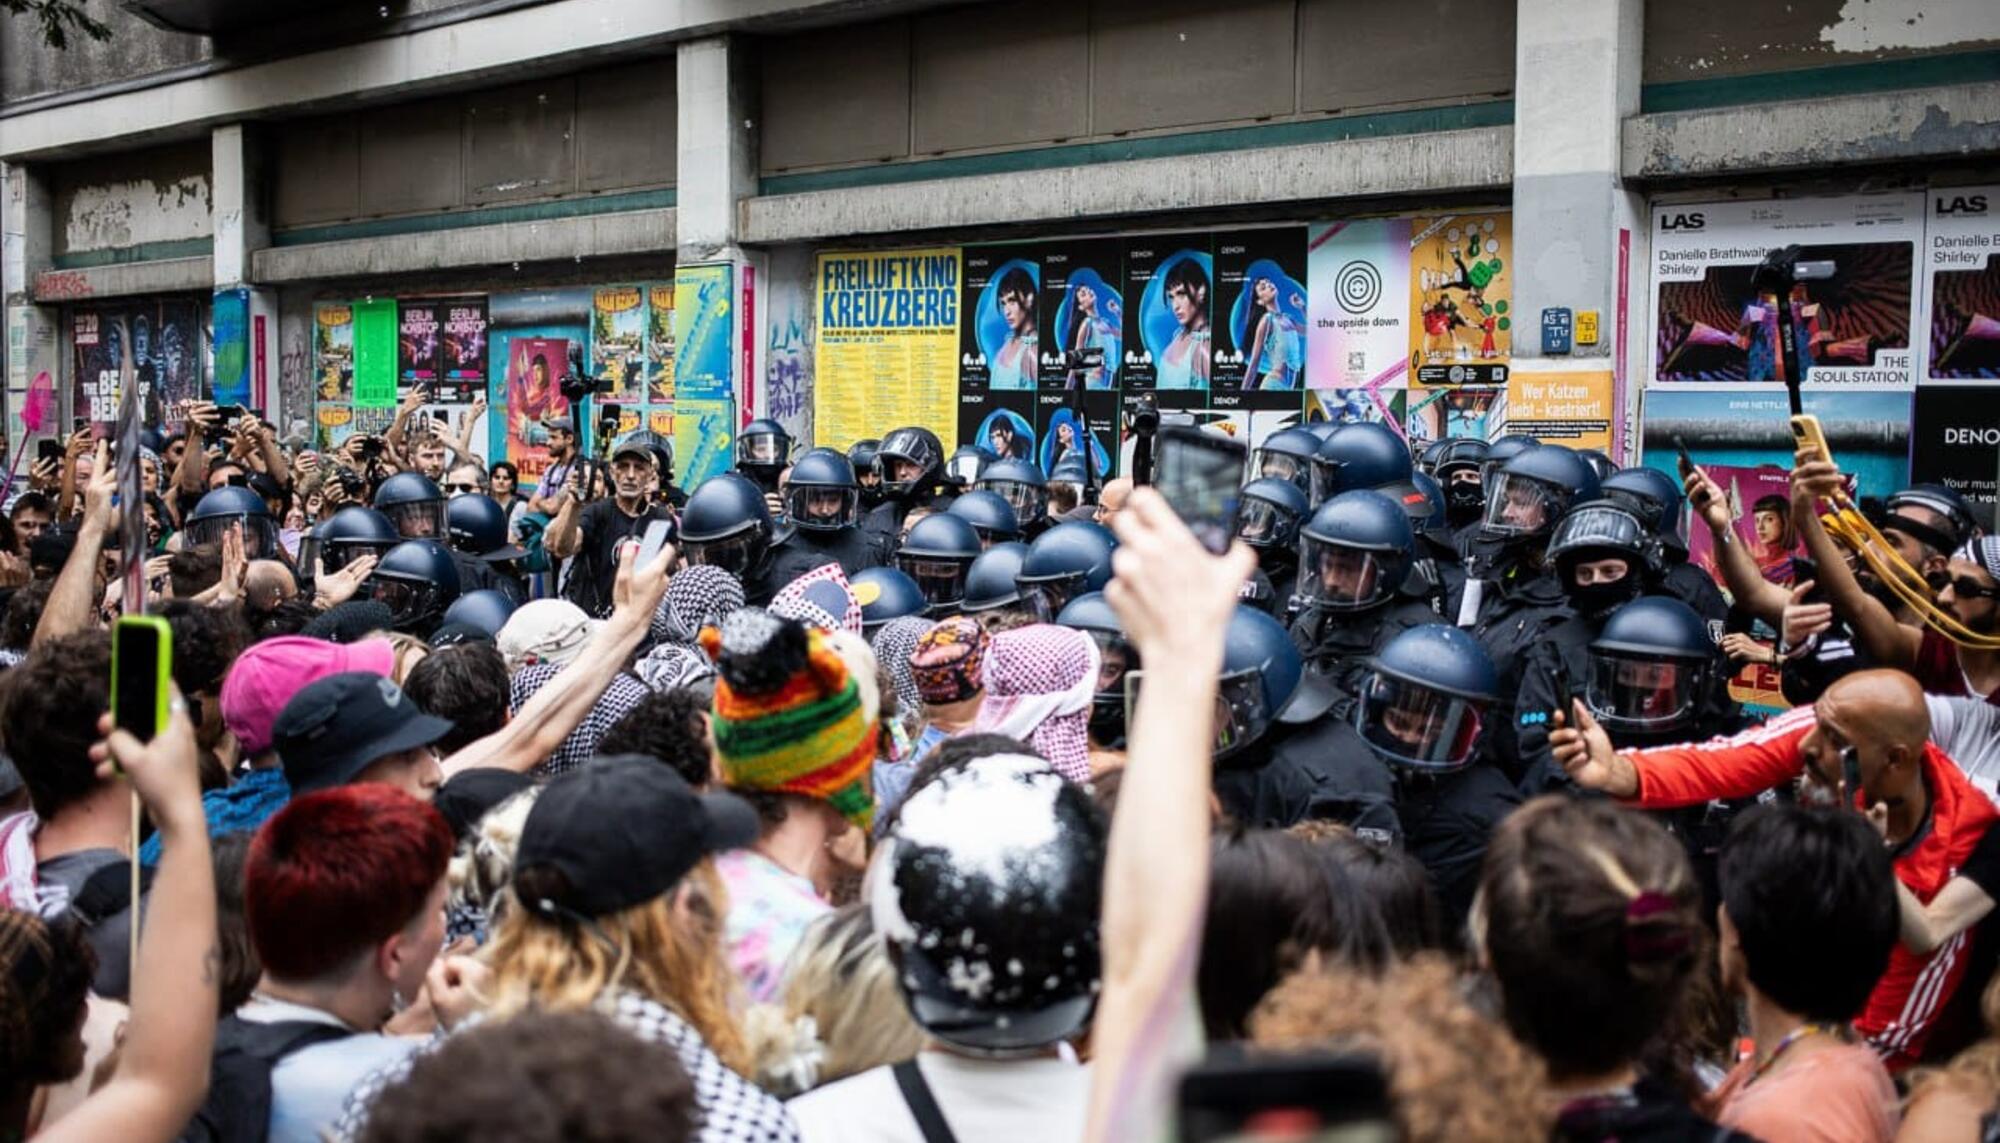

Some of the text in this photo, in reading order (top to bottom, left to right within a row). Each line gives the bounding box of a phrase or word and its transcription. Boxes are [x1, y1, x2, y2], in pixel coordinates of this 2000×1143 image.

[1937, 195, 1988, 213] LAS
[1660, 213, 1705, 230] LAS
[1934, 234, 1990, 248] Danielle
[1659, 248, 1707, 261] Danielle
[1934, 250, 1980, 265] Shirley
[823, 255, 957, 290] FREILUFTKINO
[1659, 262, 1699, 277] Shirley
[823, 288, 957, 328] KREUZBERG
[1317, 316, 1399, 330] the upside down
[1882, 356, 1909, 368] THE
[1813, 371, 1909, 383] SOUL STATION
[1521, 383, 1589, 399] Wer Katzen
[90, 396, 146, 421] BERN
[1944, 428, 2000, 445] DENO
[516, 458, 551, 476] KLE
[1942, 477, 1997, 489] Your mus
[1731, 664, 1779, 692] LE
